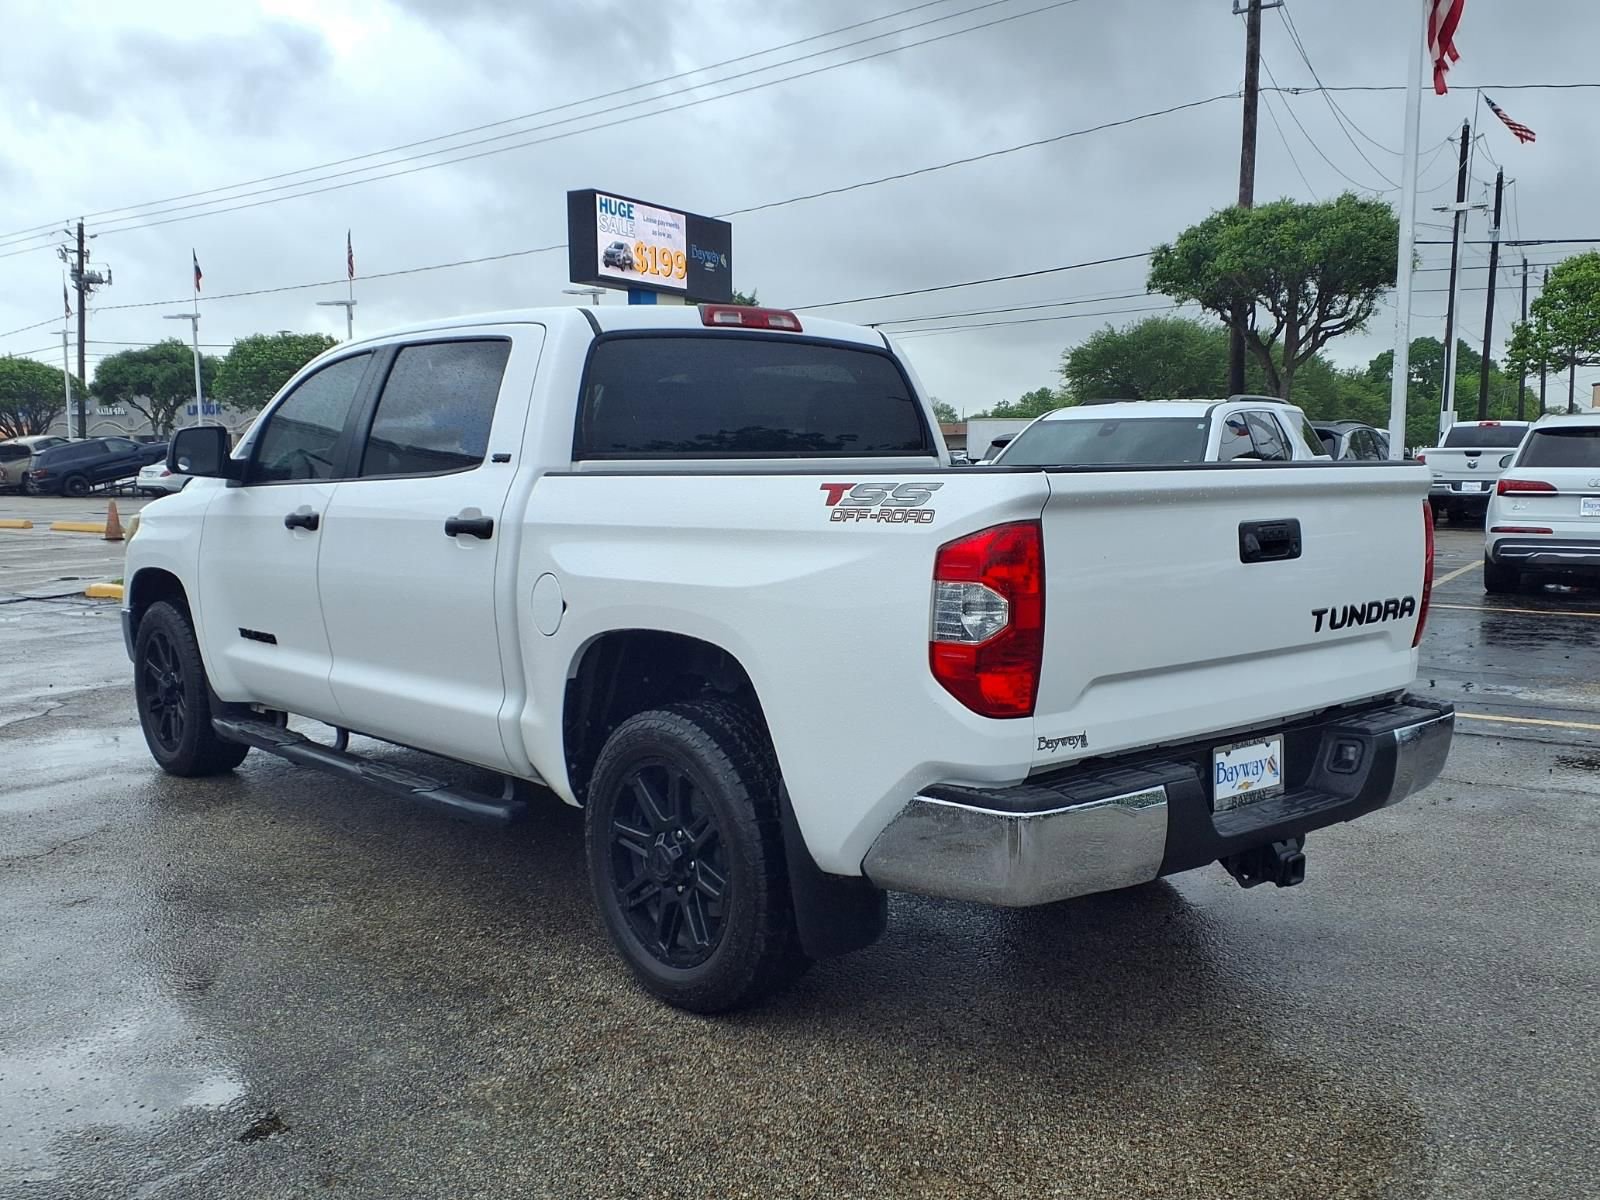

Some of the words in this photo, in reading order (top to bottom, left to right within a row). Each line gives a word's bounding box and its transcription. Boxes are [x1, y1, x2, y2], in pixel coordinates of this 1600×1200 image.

[599, 197, 634, 220] HUGE
[599, 215, 636, 238] SALE
[657, 218, 680, 230] payments
[634, 241, 687, 279] $199
[691, 244, 720, 266] Bayway
[820, 483, 944, 507] TSS
[830, 508, 936, 523] OFF-ROAD
[1311, 595, 1416, 633] TUNDRA
[1037, 734, 1081, 752] Bayway
[1216, 757, 1268, 789] Bayway
